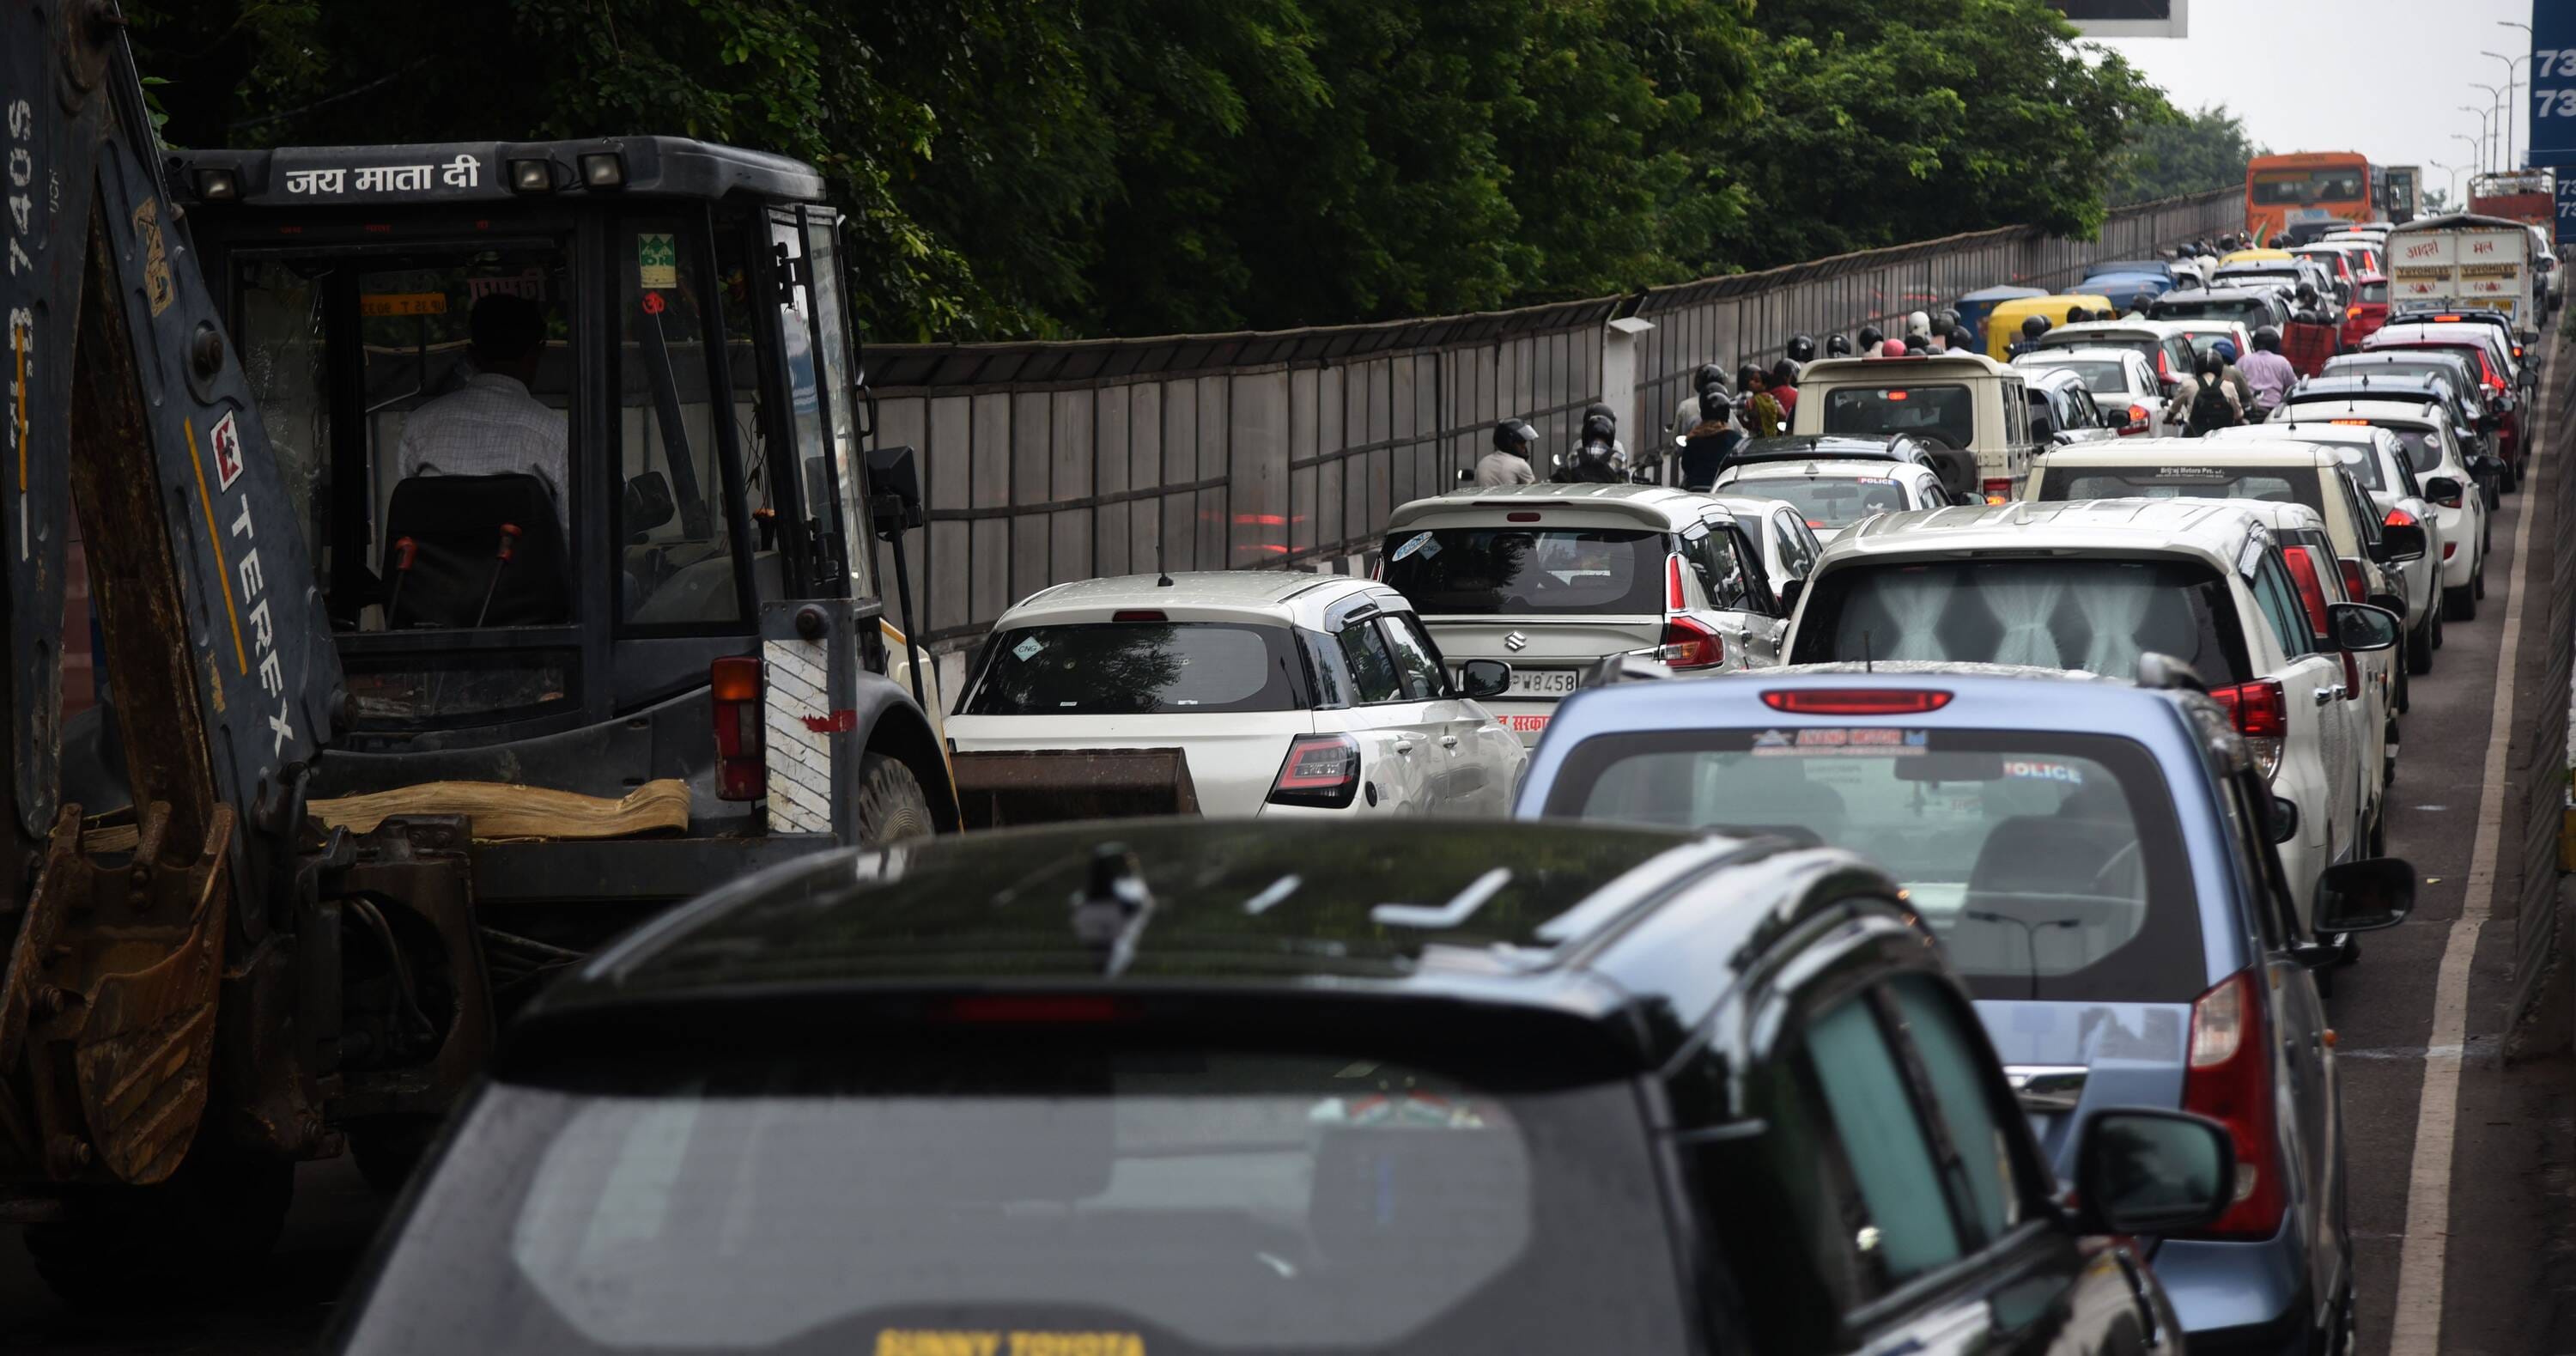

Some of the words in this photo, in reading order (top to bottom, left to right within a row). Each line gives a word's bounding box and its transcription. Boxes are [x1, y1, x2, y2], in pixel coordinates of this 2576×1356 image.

[2536, 49, 2576, 77] 73
[2535, 89, 2576, 118] 73
[8, 99, 33, 277] 740S
[286, 169, 347, 194] जय
[355, 165, 434, 192] माता
[442, 155, 481, 187] दी
[1861, 477, 1894, 486] POLICE
[231, 493, 295, 758] TEREX
[1018, 645, 1037, 654] CNG
[1512, 715, 1552, 732] सरका
